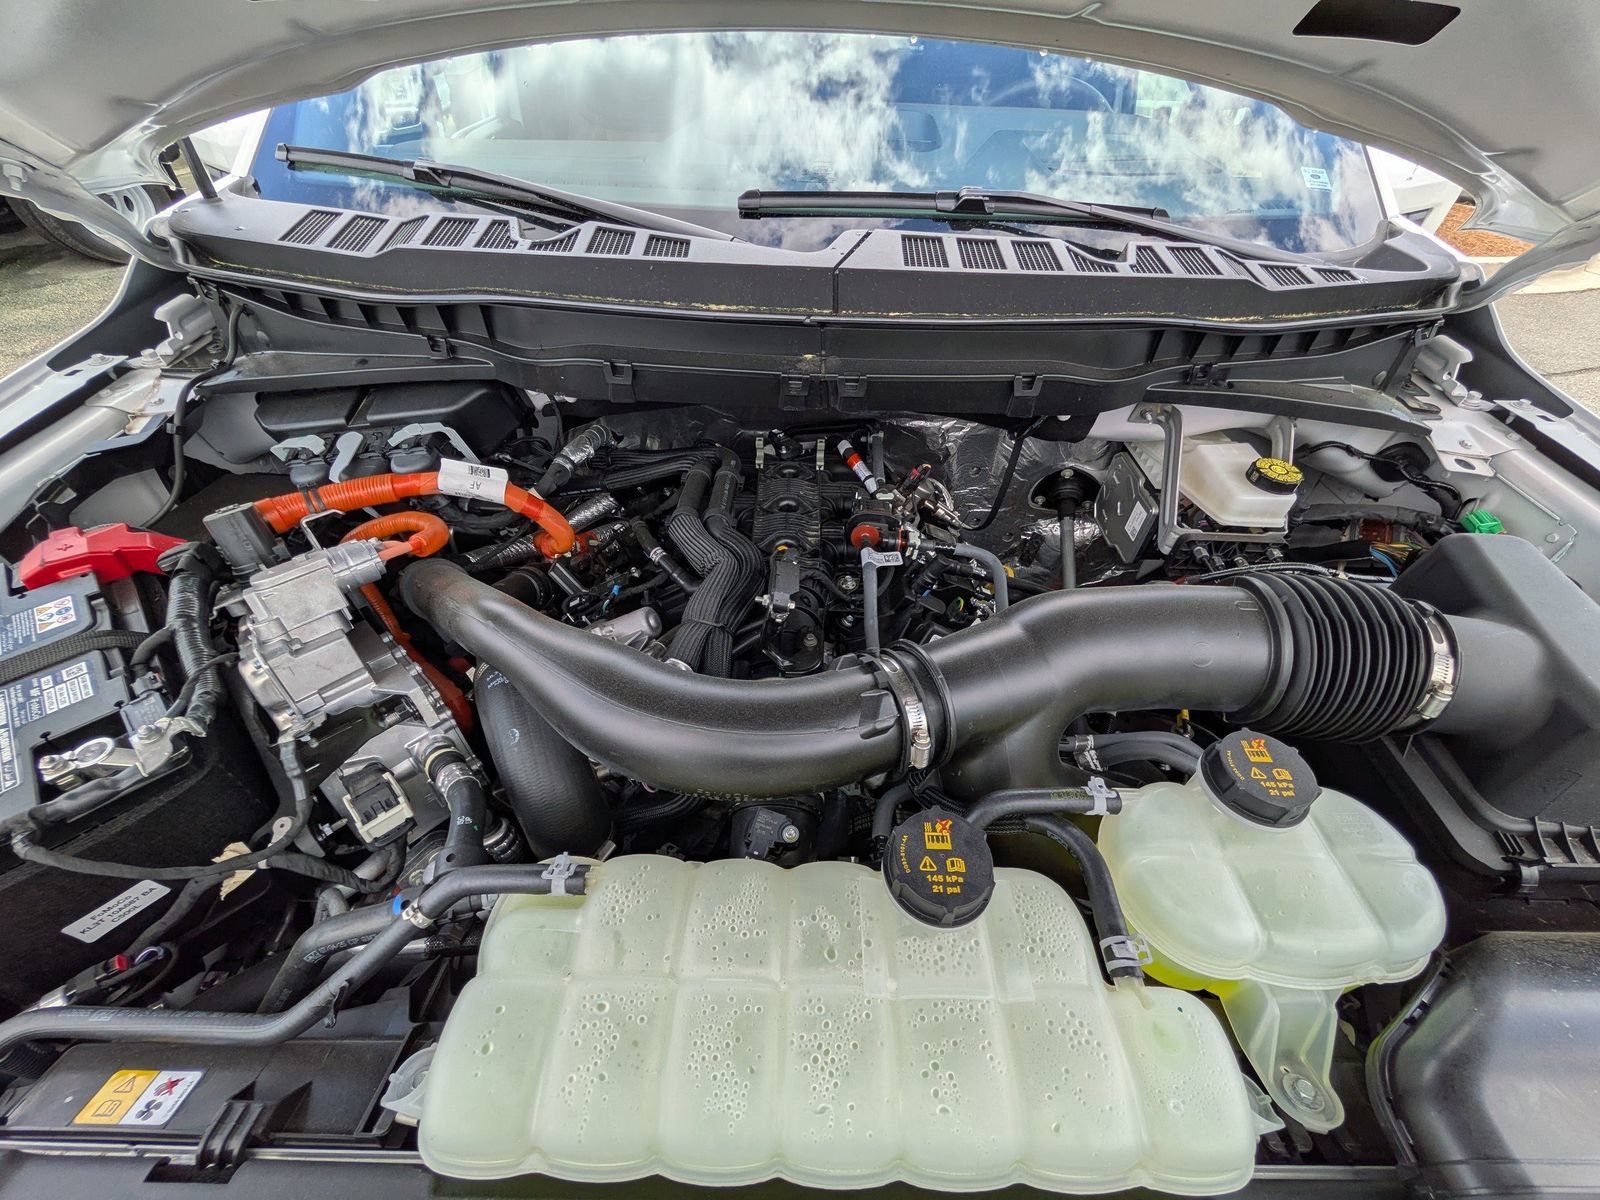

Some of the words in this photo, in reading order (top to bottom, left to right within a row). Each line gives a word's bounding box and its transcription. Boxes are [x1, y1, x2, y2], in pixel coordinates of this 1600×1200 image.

[926, 874, 944, 883] 145
[945, 875, 964, 883] kPa
[931, 884, 944, 893] 21
[946, 885, 961, 895] psi
[79, 918, 105, 934] KL3T
[140, 887, 158, 897] BA
[90, 895, 132, 920] FoMoCo
